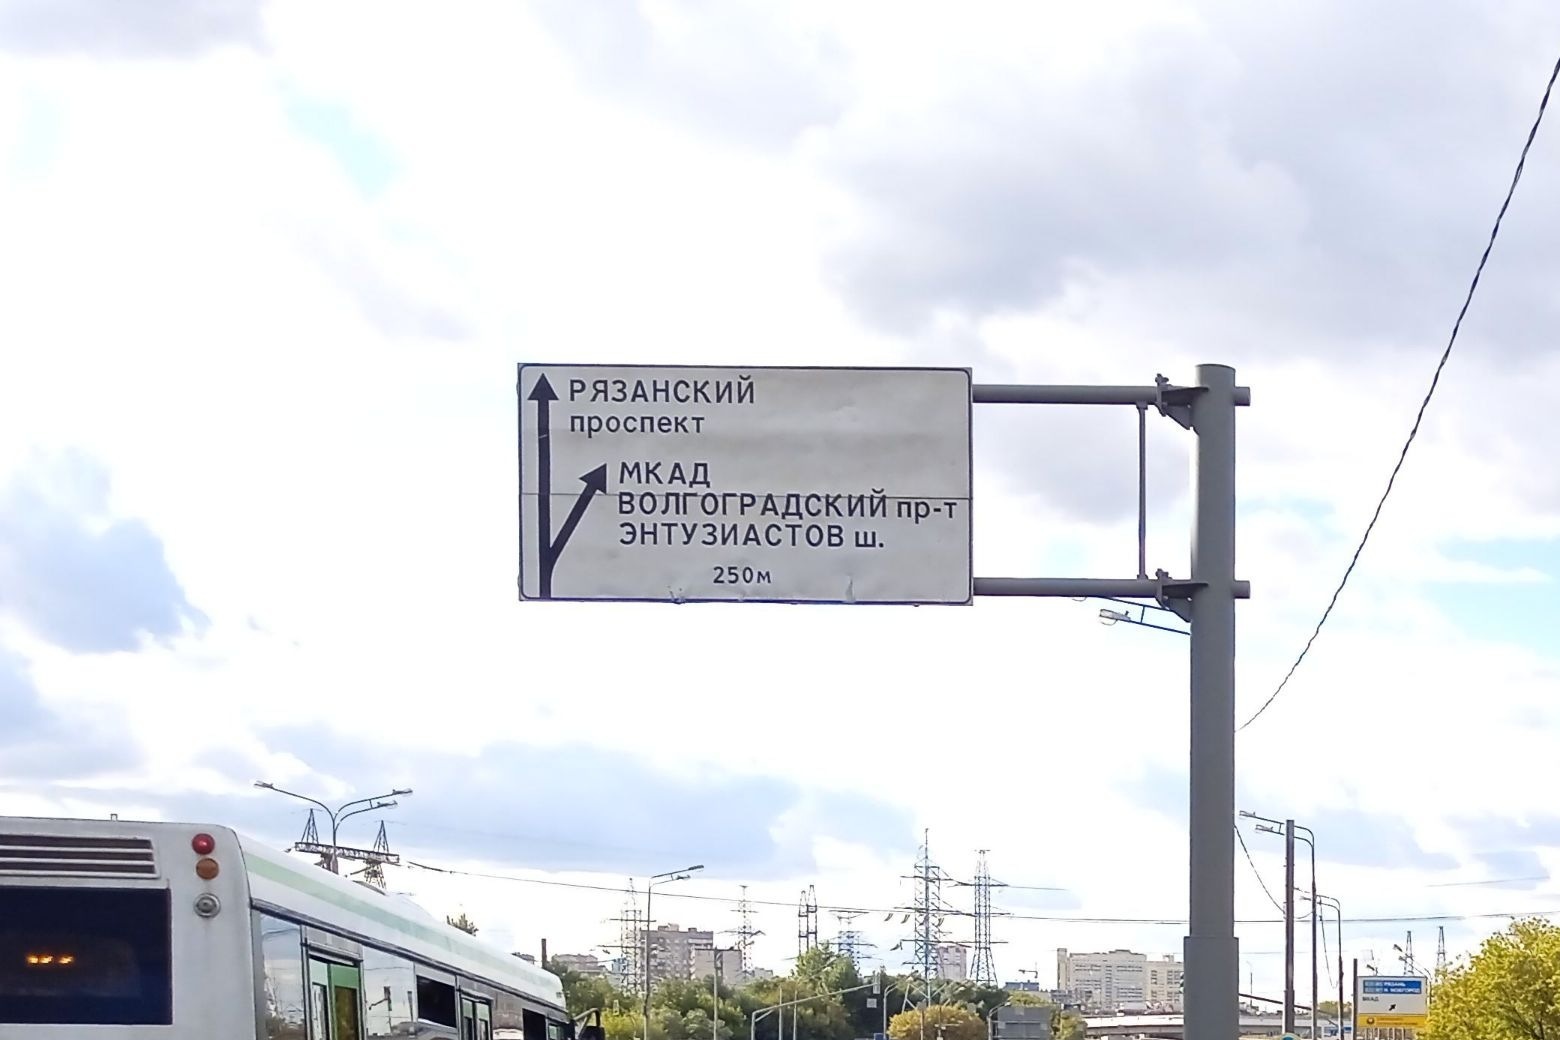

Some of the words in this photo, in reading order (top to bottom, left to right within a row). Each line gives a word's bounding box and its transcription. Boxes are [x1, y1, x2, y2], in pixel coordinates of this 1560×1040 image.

[569, 375, 755, 404] РЯЗАНСКИЙ
[569, 414, 705, 438] проспект
[618, 462, 711, 488] МКАД
[618, 489, 888, 520] ВОЛГОГРАДСКИЙ
[897, 501, 957, 524] пр-т
[619, 523, 844, 548] ЭНТУЗИАСТОВ
[855, 531, 885, 548] ш.
[712, 566, 772, 584] 250м
